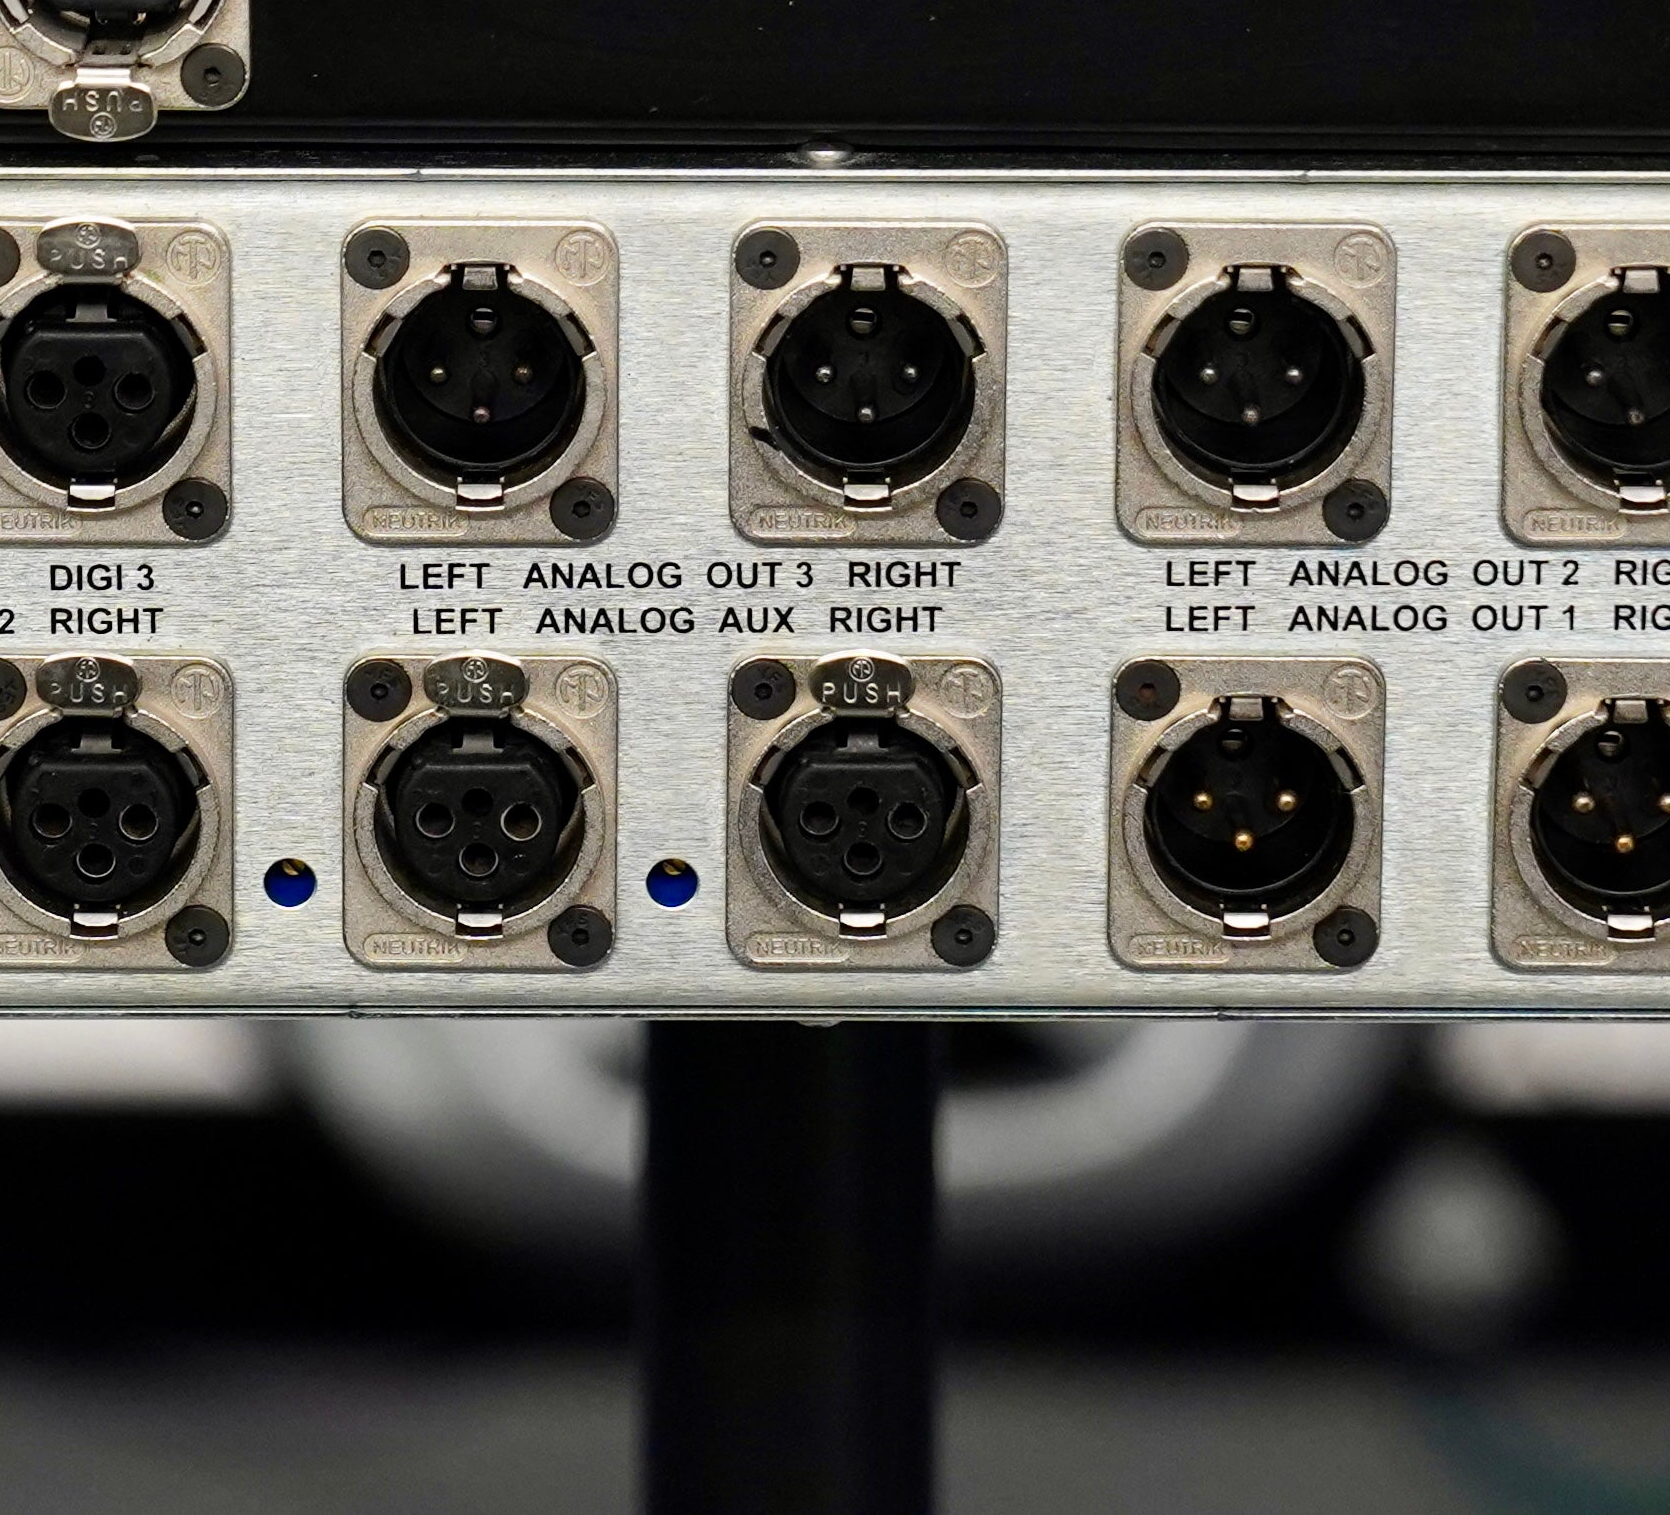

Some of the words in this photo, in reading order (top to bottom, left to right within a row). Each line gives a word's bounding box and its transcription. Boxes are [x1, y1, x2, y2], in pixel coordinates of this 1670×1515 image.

[372, 512, 461, 529] NEUTRIK
[758, 512, 848, 529] NEUTRIK
[1145, 512, 1234, 529] NEUTRIK
[1531, 515, 1620, 532] NEUTRIK
[49, 563, 123, 591] DIGI
[136, 563, 155, 591] 3
[400, 562, 491, 590] LEFT
[522, 561, 682, 589] ANALOG
[706, 561, 783, 590] OUT
[796, 561, 814, 588] 3
[848, 560, 962, 588] RIGHT
[1166, 560, 1257, 587] LEFT
[1288, 559, 1449, 587] ANALOG
[1473, 559, 1549, 587] OUT
[1561, 559, 1579, 586] 2
[50, 607, 164, 635] RIGHT
[413, 607, 504, 635] LEFT
[535, 606, 695, 635] ANALOG
[718, 606, 795, 634] AUX
[830, 606, 943, 633] RIGHT
[1166, 605, 1256, 632] LEFT
[1288, 604, 1448, 632] ANALOG
[1472, 604, 1549, 632] OUT
[1562, 605, 1575, 631] 1
[50, 682, 127, 703] PUSH
[438, 682, 515, 703] PUSH
[822, 681, 902, 703] PUSH
[372, 939, 462, 956] NEUTRIK
[755, 939, 845, 956] NEUTRIK
[1138, 939, 1224, 956] NEUTRIK
